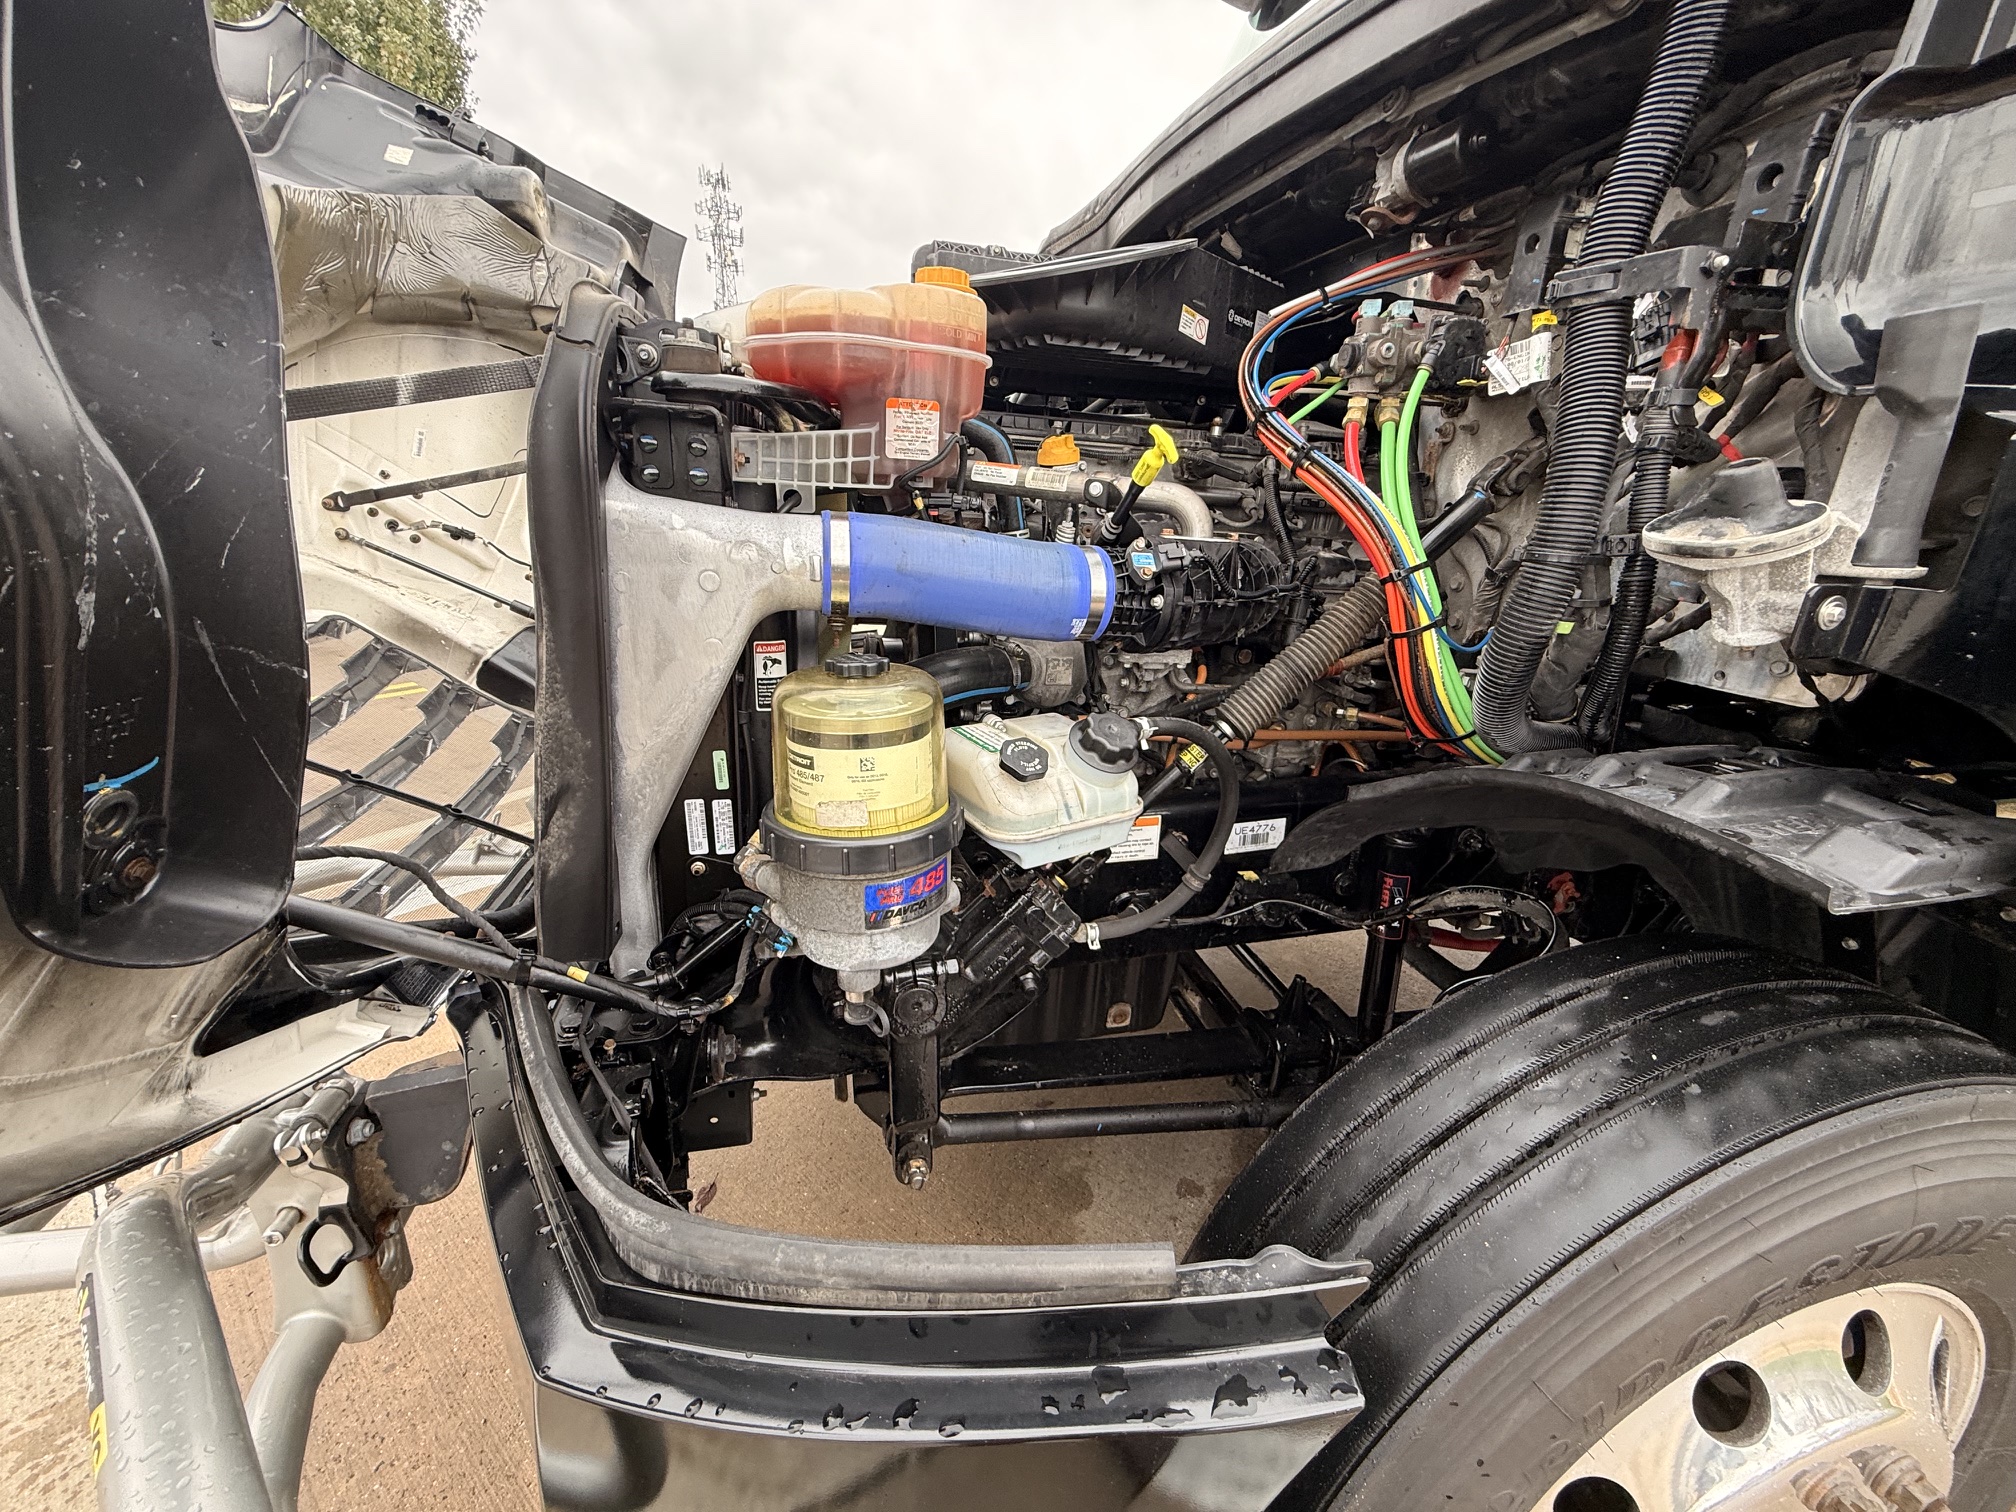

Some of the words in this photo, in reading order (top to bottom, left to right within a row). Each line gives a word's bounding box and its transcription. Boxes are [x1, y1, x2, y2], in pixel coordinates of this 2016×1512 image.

[1233, 314, 1254, 328] DETROIT
[762, 644, 785, 653] DANGER
[1190, 745, 1206, 760] STEP
[796, 769, 825, 783] 485/487
[1234, 823, 1276, 836] UE4776
[909, 863, 945, 896] 485
[882, 899, 928, 921] DAVCO
